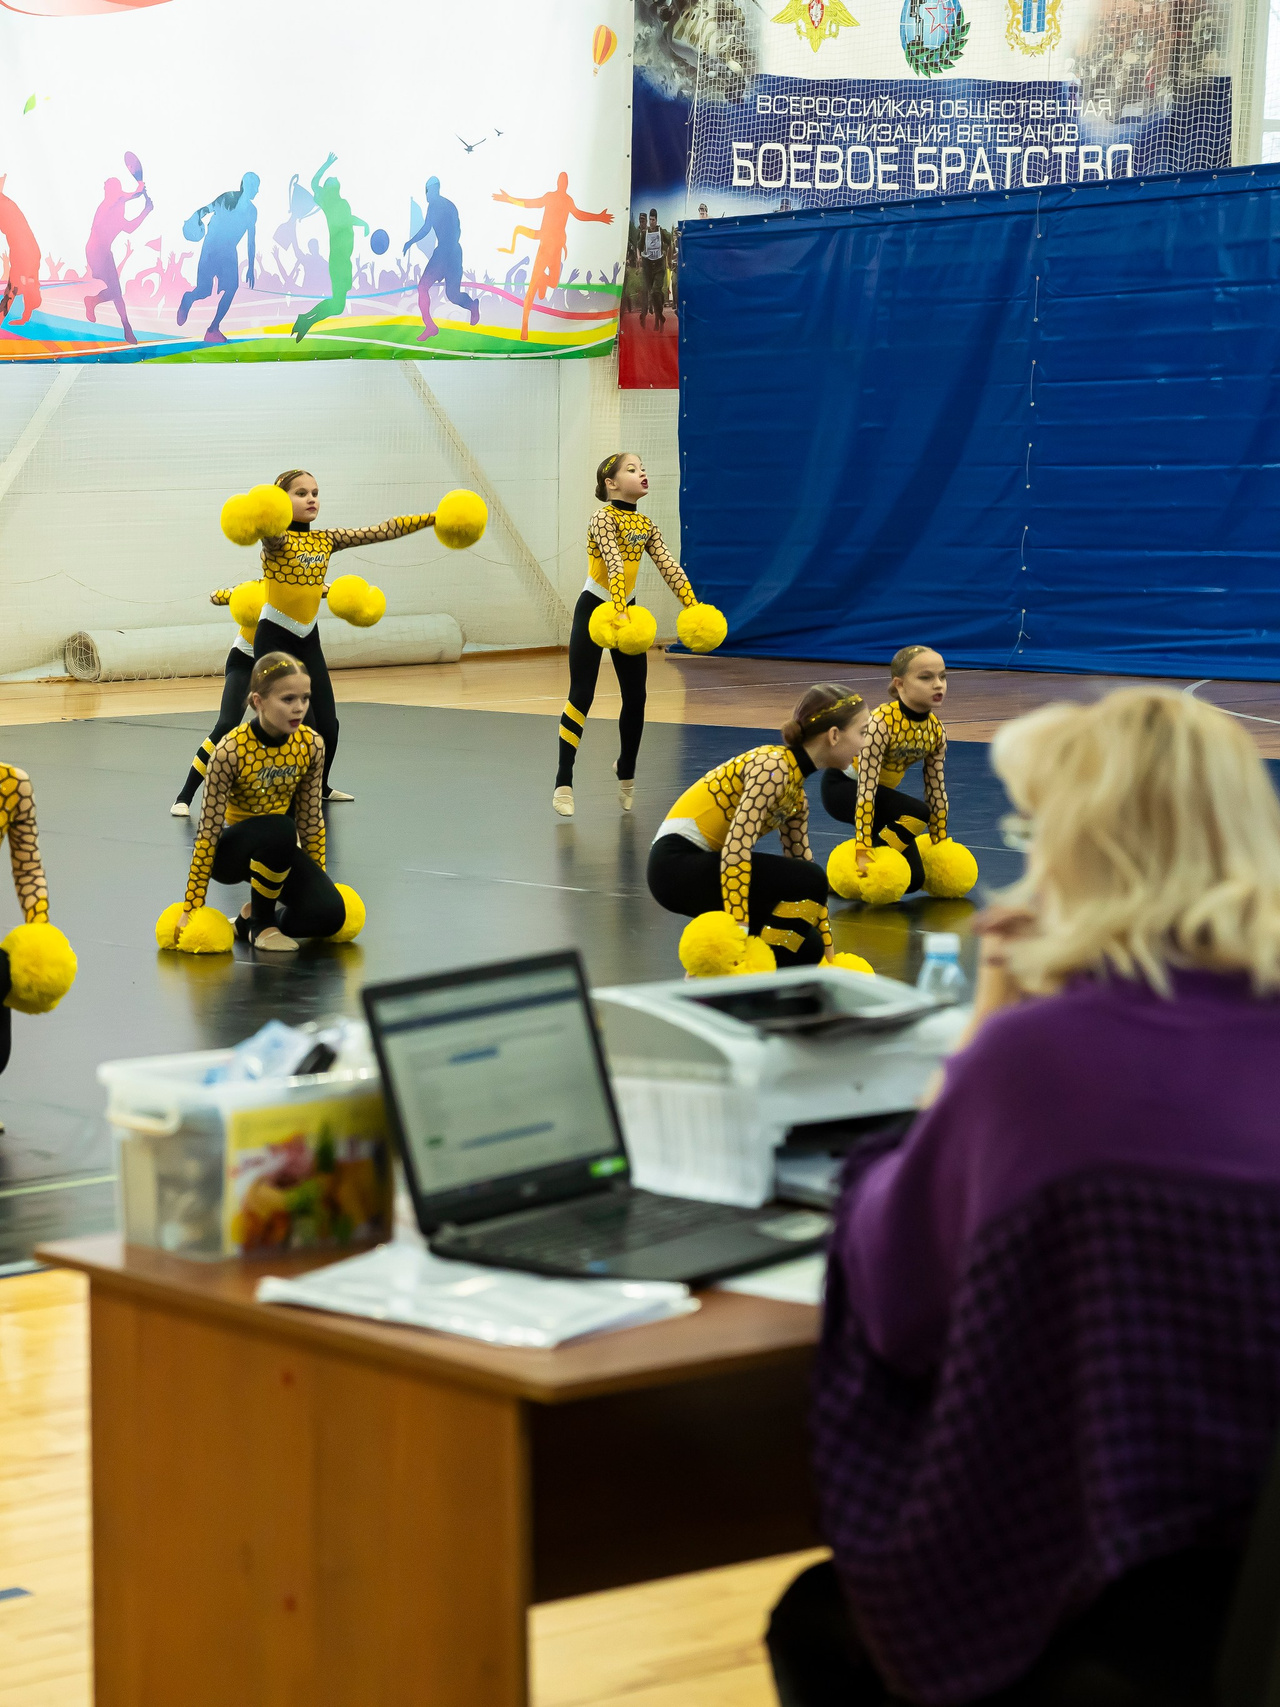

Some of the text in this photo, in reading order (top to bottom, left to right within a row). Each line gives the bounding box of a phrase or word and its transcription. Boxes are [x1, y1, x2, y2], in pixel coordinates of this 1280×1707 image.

[757, 95, 1112, 122] ВСЕРОССИЙКАЯ ОБЩЕСТВЕННАЯ
[790, 121, 1079, 146] ОРГАНИЗАЦИЯ ВЕТЕРАНОВ
[732, 141, 1133, 191] БОЕВОЕ БРАТСТВО
